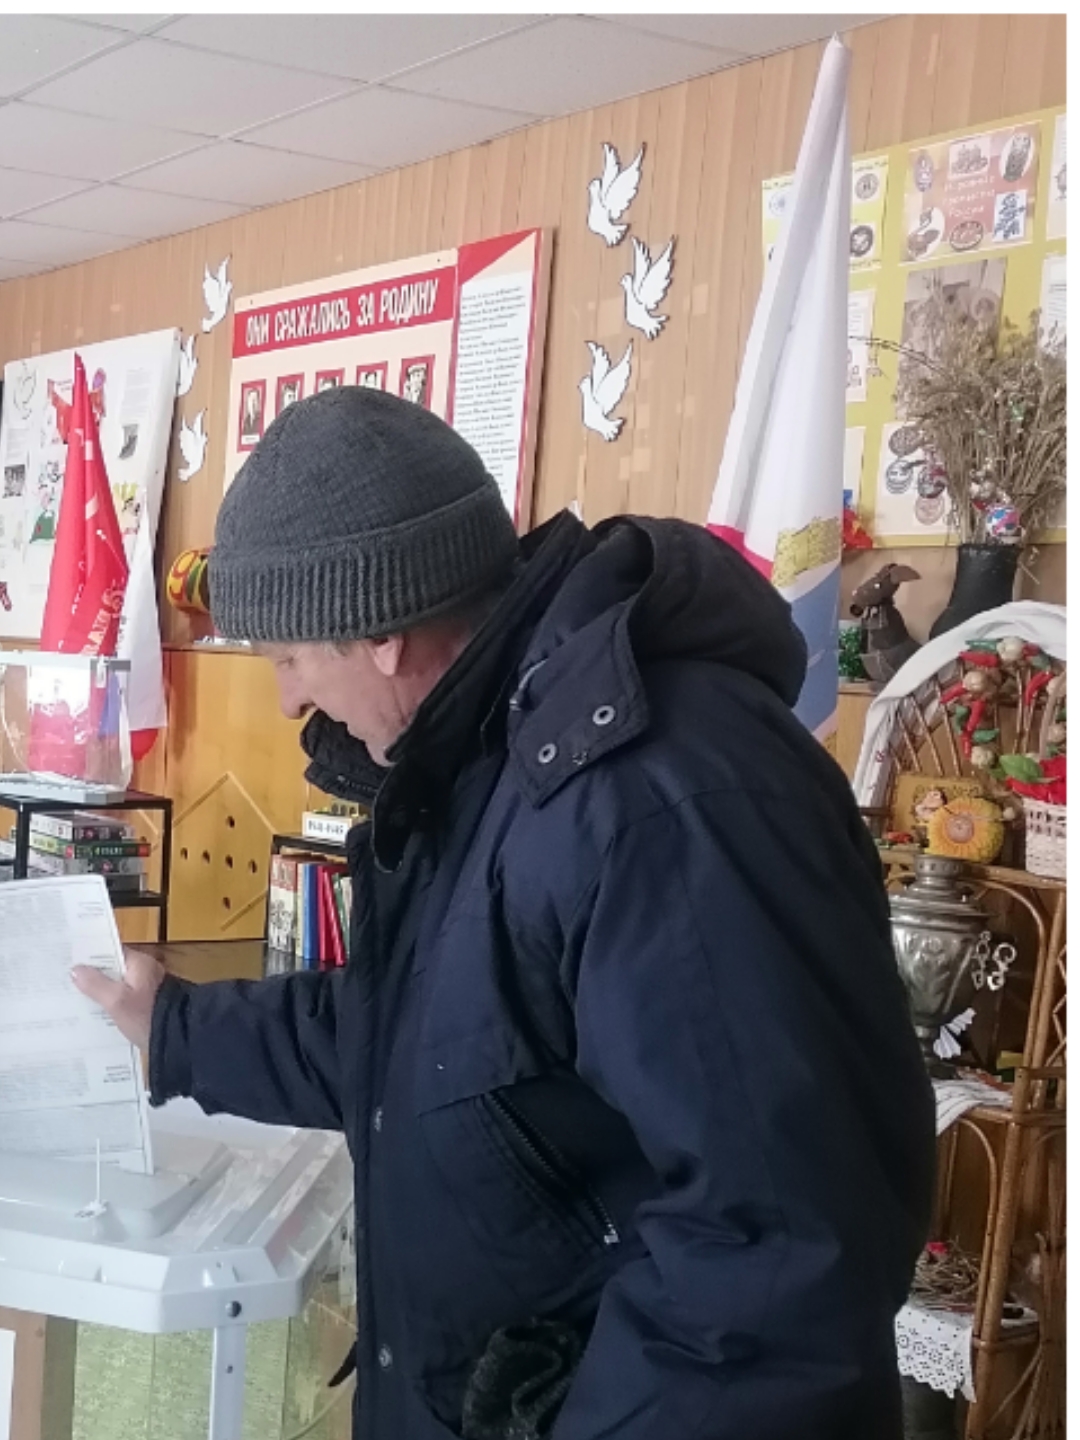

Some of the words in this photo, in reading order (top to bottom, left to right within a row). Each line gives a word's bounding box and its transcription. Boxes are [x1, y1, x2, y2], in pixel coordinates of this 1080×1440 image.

[246, 313, 270, 348] ОНИ
[274, 298, 350, 342] СРАЖАЛИСЬ
[356, 292, 375, 327] ЗА
[378, 278, 439, 325] РОДИНУ
